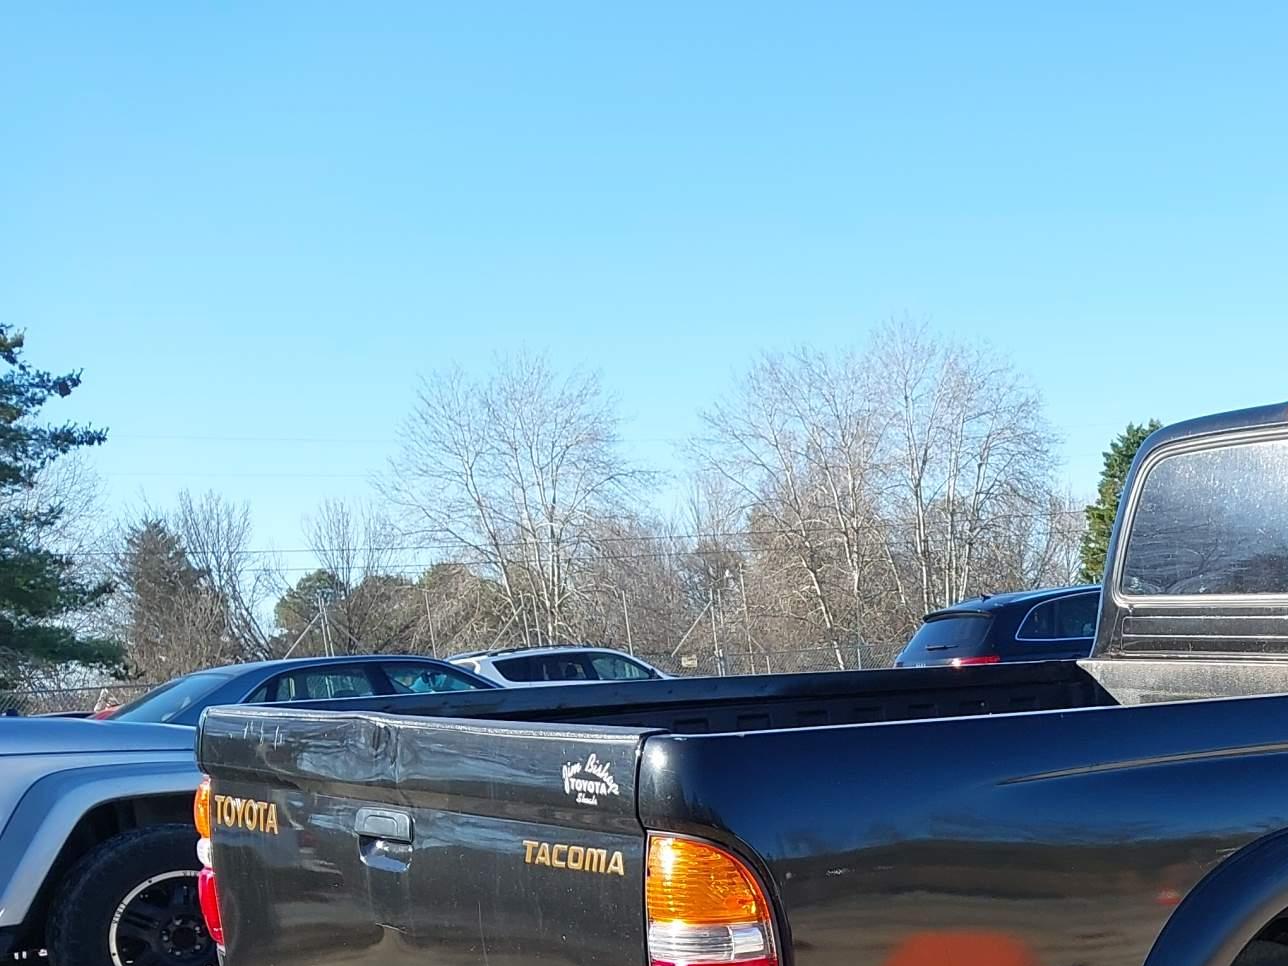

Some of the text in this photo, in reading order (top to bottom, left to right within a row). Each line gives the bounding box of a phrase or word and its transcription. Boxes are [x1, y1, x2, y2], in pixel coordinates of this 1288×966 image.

[569, 777, 607, 796] TOYOTA
[214, 794, 279, 835] TOYOTA
[522, 839, 625, 876] TACOMA
